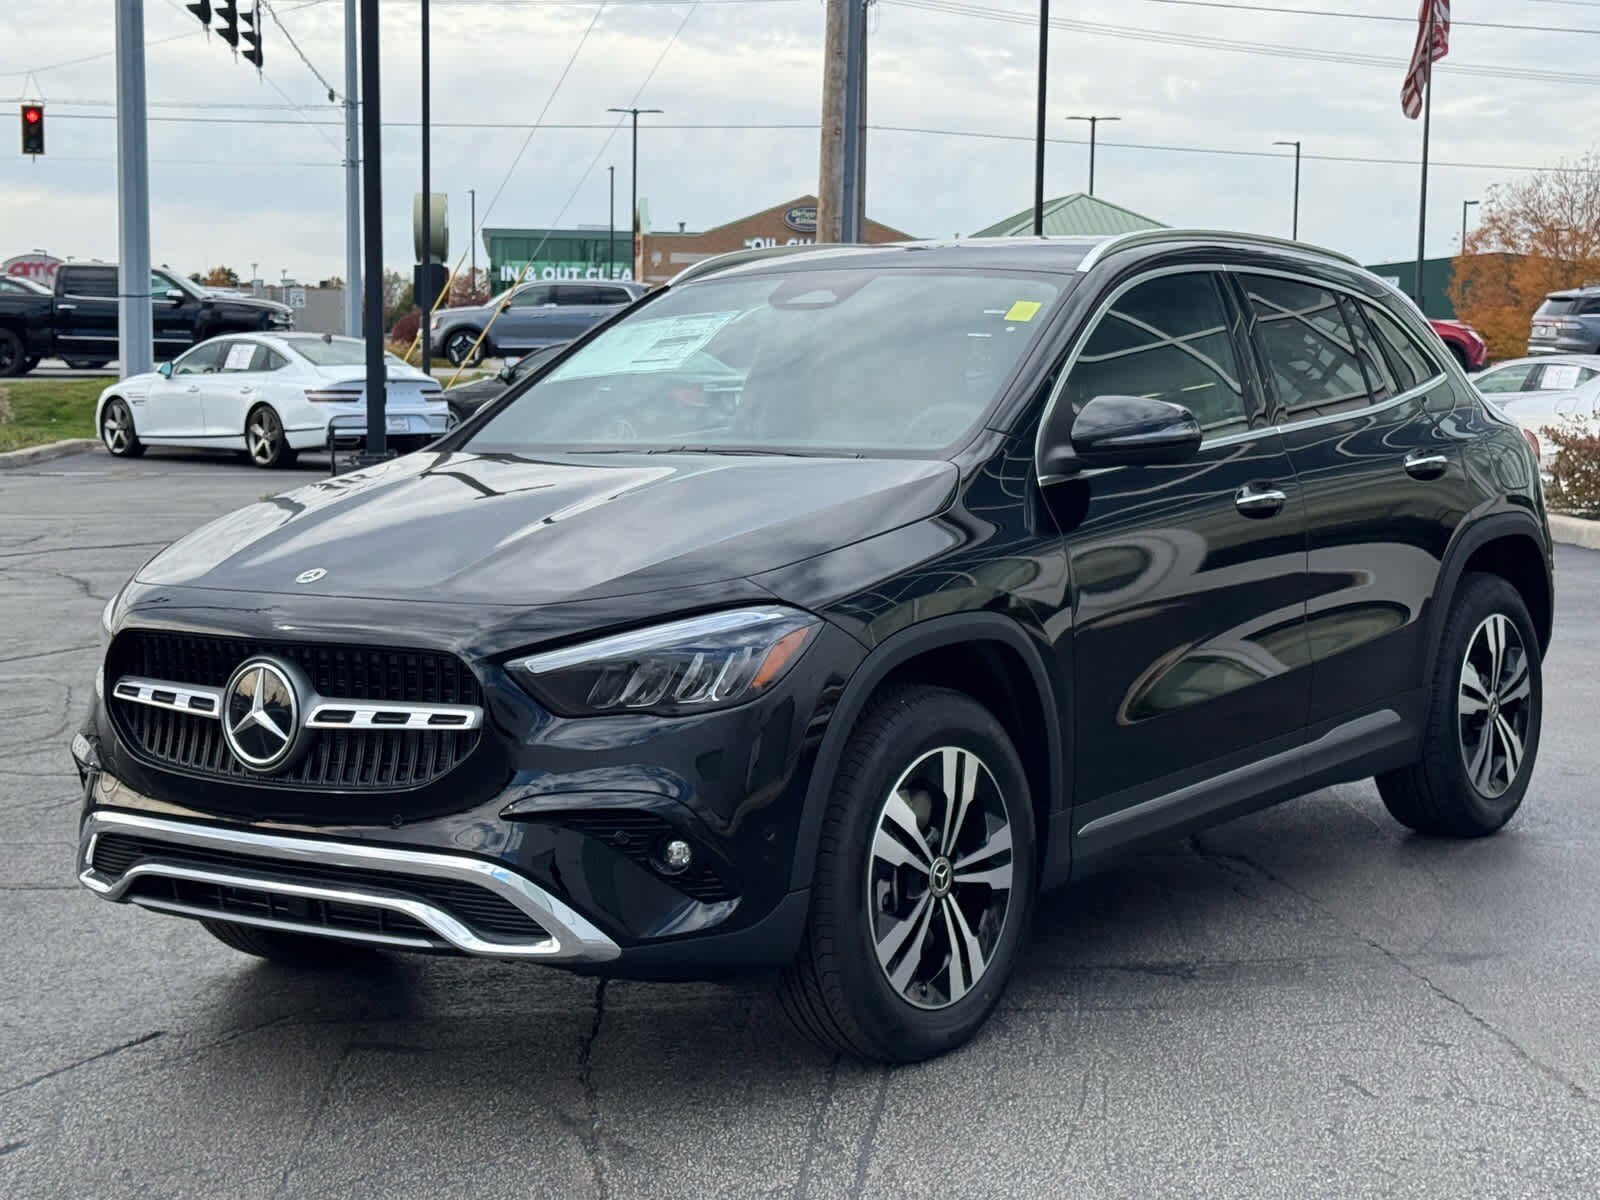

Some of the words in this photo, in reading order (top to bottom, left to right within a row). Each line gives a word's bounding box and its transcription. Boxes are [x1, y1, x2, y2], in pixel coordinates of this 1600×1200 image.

[500, 265, 519, 281] IN
[526, 266, 536, 280] &
[542, 267, 580, 281] OUT
